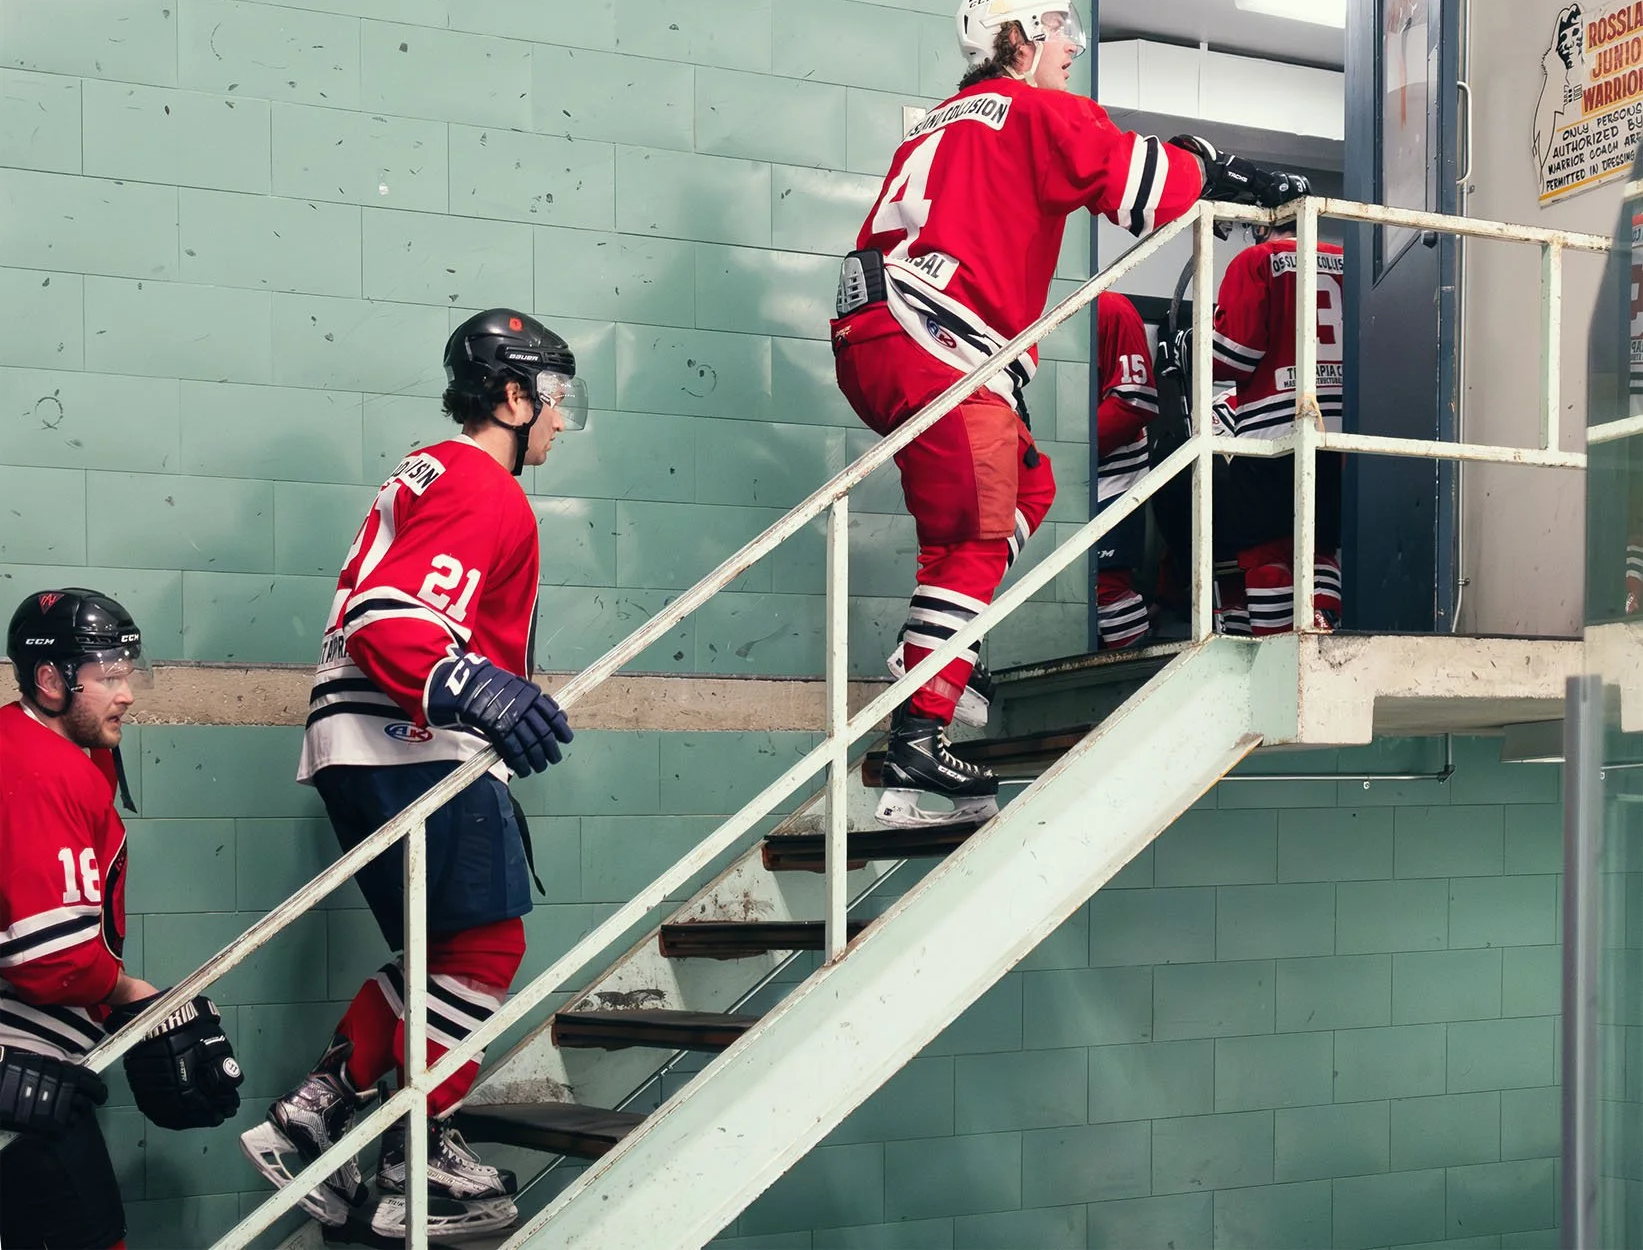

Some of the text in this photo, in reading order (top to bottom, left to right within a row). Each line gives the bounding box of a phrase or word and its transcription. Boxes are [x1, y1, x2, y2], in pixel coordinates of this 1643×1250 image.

[1553, 115, 1643, 158] AUTHORIZED BY
[1562, 103, 1643, 141] ONLY PERSONS
[1548, 153, 1585, 175] WARRIOR
[1589, 140, 1618, 160] COACH
[1546, 169, 1586, 191] PERMITTED
[1590, 163, 1599, 176] IN
[872, 128, 946, 259] 4
[1272, 255, 1297, 273] OSSL
[509, 353, 539, 361] BAUER
[1119, 354, 1147, 384] 15
[417, 553, 481, 622] 21
[121, 633, 140, 642] CCM
[938, 765, 967, 782] CCM
